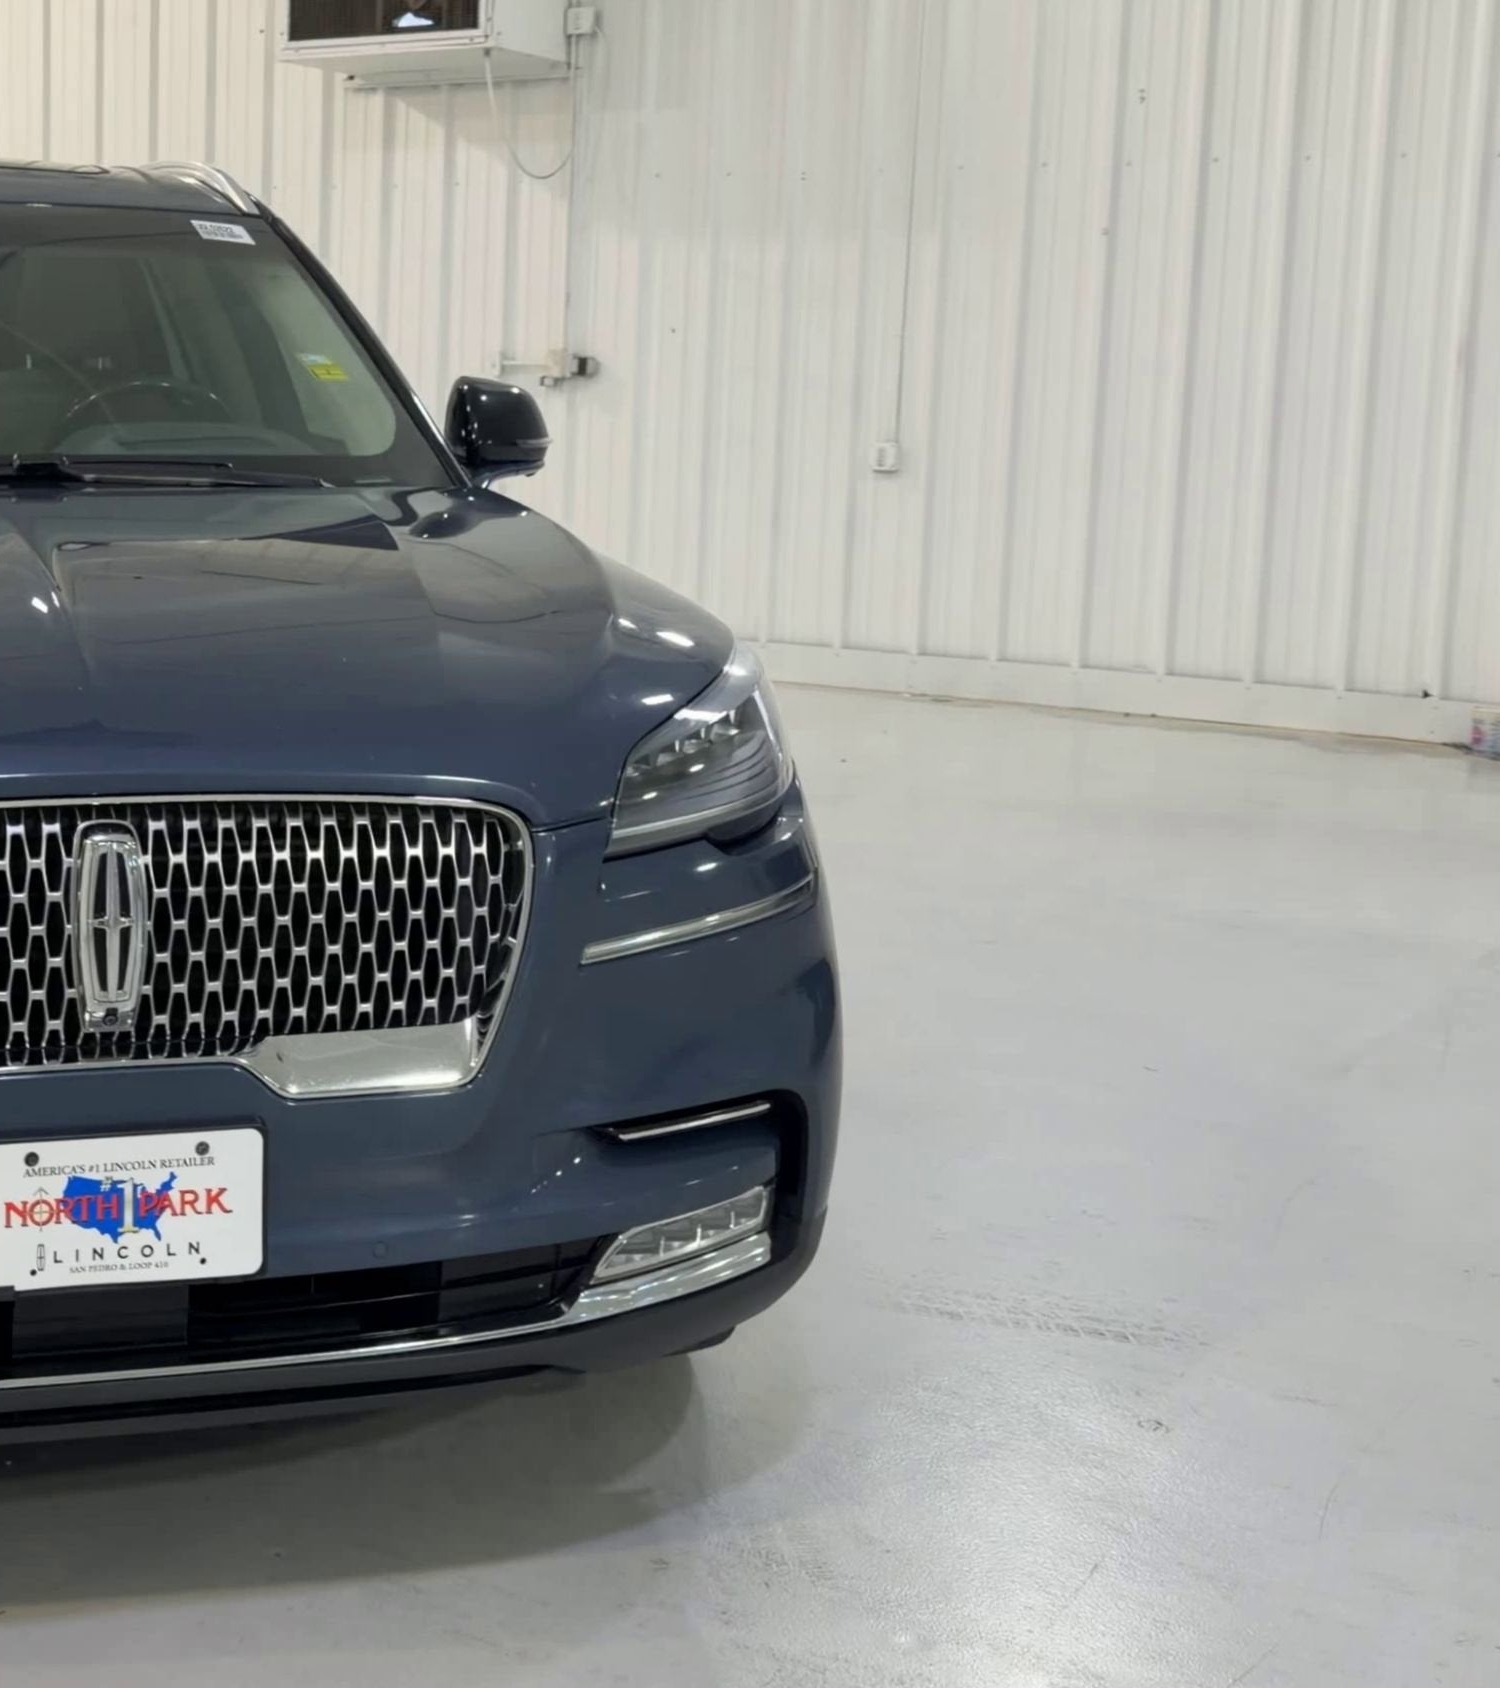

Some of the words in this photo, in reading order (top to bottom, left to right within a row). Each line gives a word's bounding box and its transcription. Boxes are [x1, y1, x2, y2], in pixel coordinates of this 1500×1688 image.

[23, 1164, 86, 1178] AMERICA'S
[88, 1162, 100, 1173] #1
[103, 1159, 157, 1173] LINCOLN
[160, 1156, 215, 1169] RETAILER
[4, 1195, 120, 1228] NORTH
[138, 1188, 233, 1217] PARK
[53, 1242, 200, 1264] LINCOLN
[69, 1264, 86, 1274] SAN
[88, 1263, 118, 1273] PEDRO
[128, 1261, 153, 1270] LOOP
